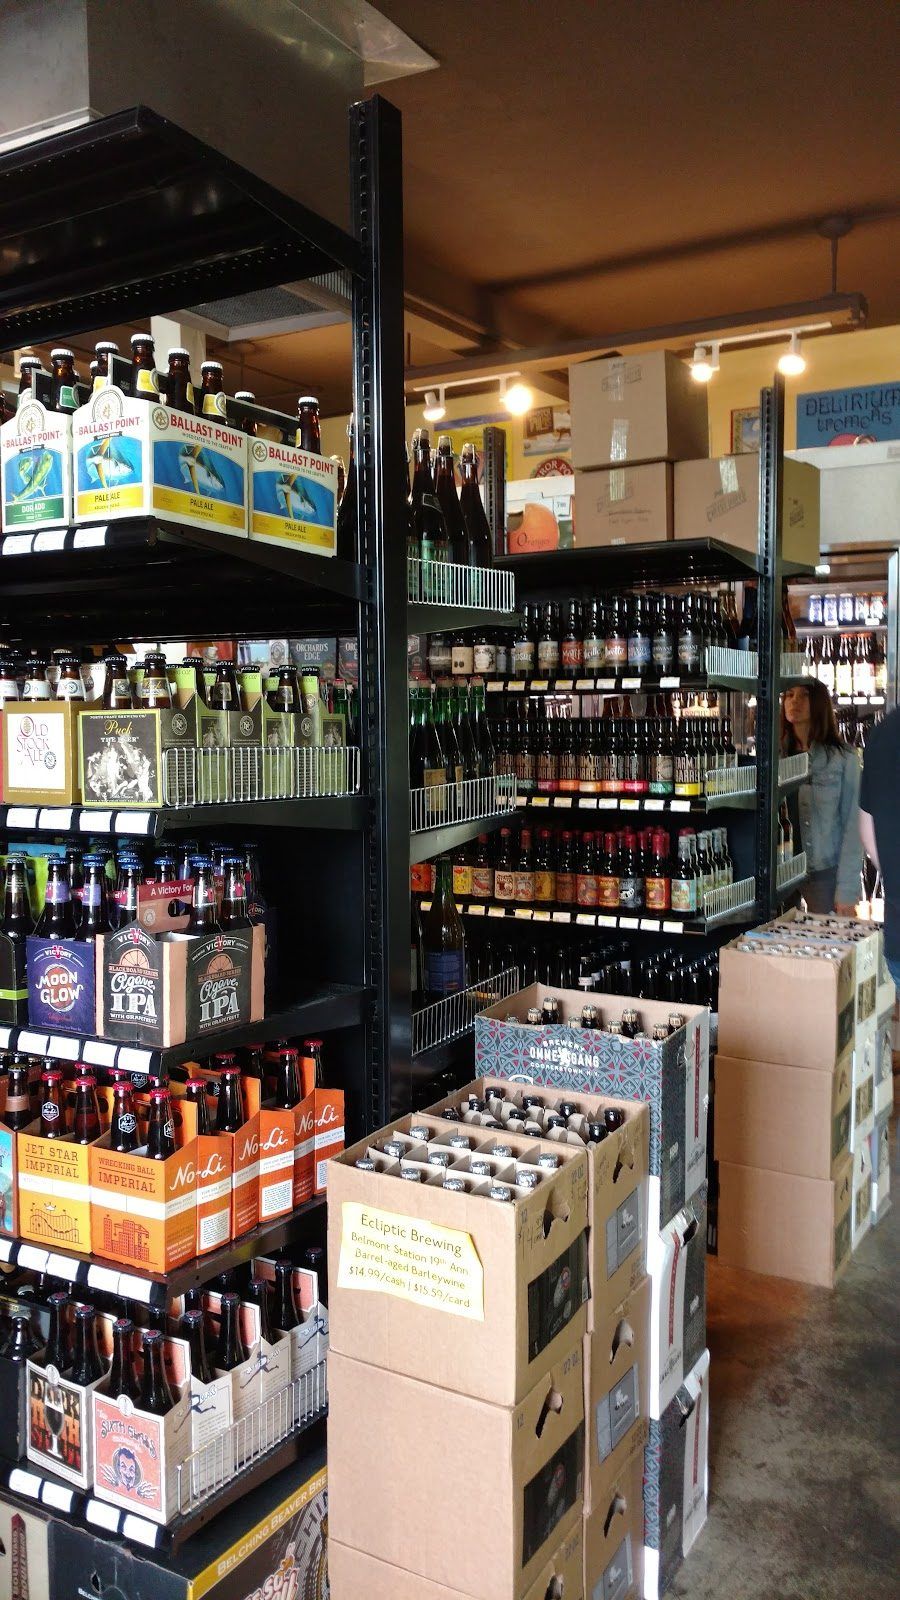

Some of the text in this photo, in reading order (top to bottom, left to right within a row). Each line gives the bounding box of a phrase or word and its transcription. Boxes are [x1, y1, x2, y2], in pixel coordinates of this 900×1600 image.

[79, 416, 141, 436] BALLAST POINT
[170, 413, 244, 449] BALLAST POINT
[5, 430, 60, 449] BALLAST POINT
[268, 446, 335, 475] BALLAST POINT
[94, 492, 121, 502] PALE ALE
[190, 498, 214, 511] PALE ALE
[21, 502, 46, 514] DORADO
[284, 522, 307, 534] PALE ALE
[296, 642, 329, 652] ORCHARD'S
[304, 651, 321, 661] EDGE
[104, 719, 134, 736] Puck
[158, 885, 181, 895] Victory
[182, 883, 193, 892] For
[117, 931, 151, 947] VICTORY
[206, 939, 236, 951] VICTORY
[45, 947, 73, 959] VICTORY
[36, 971, 78, 989] MOON
[110, 973, 156, 993] Agave
[40, 984, 84, 1004] GLOW
[200, 978, 239, 1003] Agave
[110, 993, 158, 1018] IPA
[199, 992, 240, 1022] IPA
[110, 1012, 125, 1020] WITH
[542, 1039, 585, 1052] BREWERY
[530, 1062, 583, 1075] COOPERSTOWN
[295, 1103, 340, 1137] No-Li
[24, 1143, 79, 1162] JET STAR
[238, 1126, 289, 1162] No-Li
[25, 1159, 80, 1179] IMPERIAL
[98, 1157, 156, 1176] WRECKING BALL
[169, 1153, 227, 1191] No-Li
[98, 1171, 156, 1194] IMPERIAL
[361, 1213, 462, 1258] Ecliptic Brewing
[351, 1231, 391, 1252] Belmont
[393, 1244, 427, 1263] Station
[355, 1248, 466, 1290] Barrel-aged Barleywine
[348, 1266, 406, 1289] $14.99/cash
[414, 1283, 470, 1308] $15.59/card
[216, 1525, 269, 1576] BELCHING
[270, 1491, 308, 1530] BEAVER
